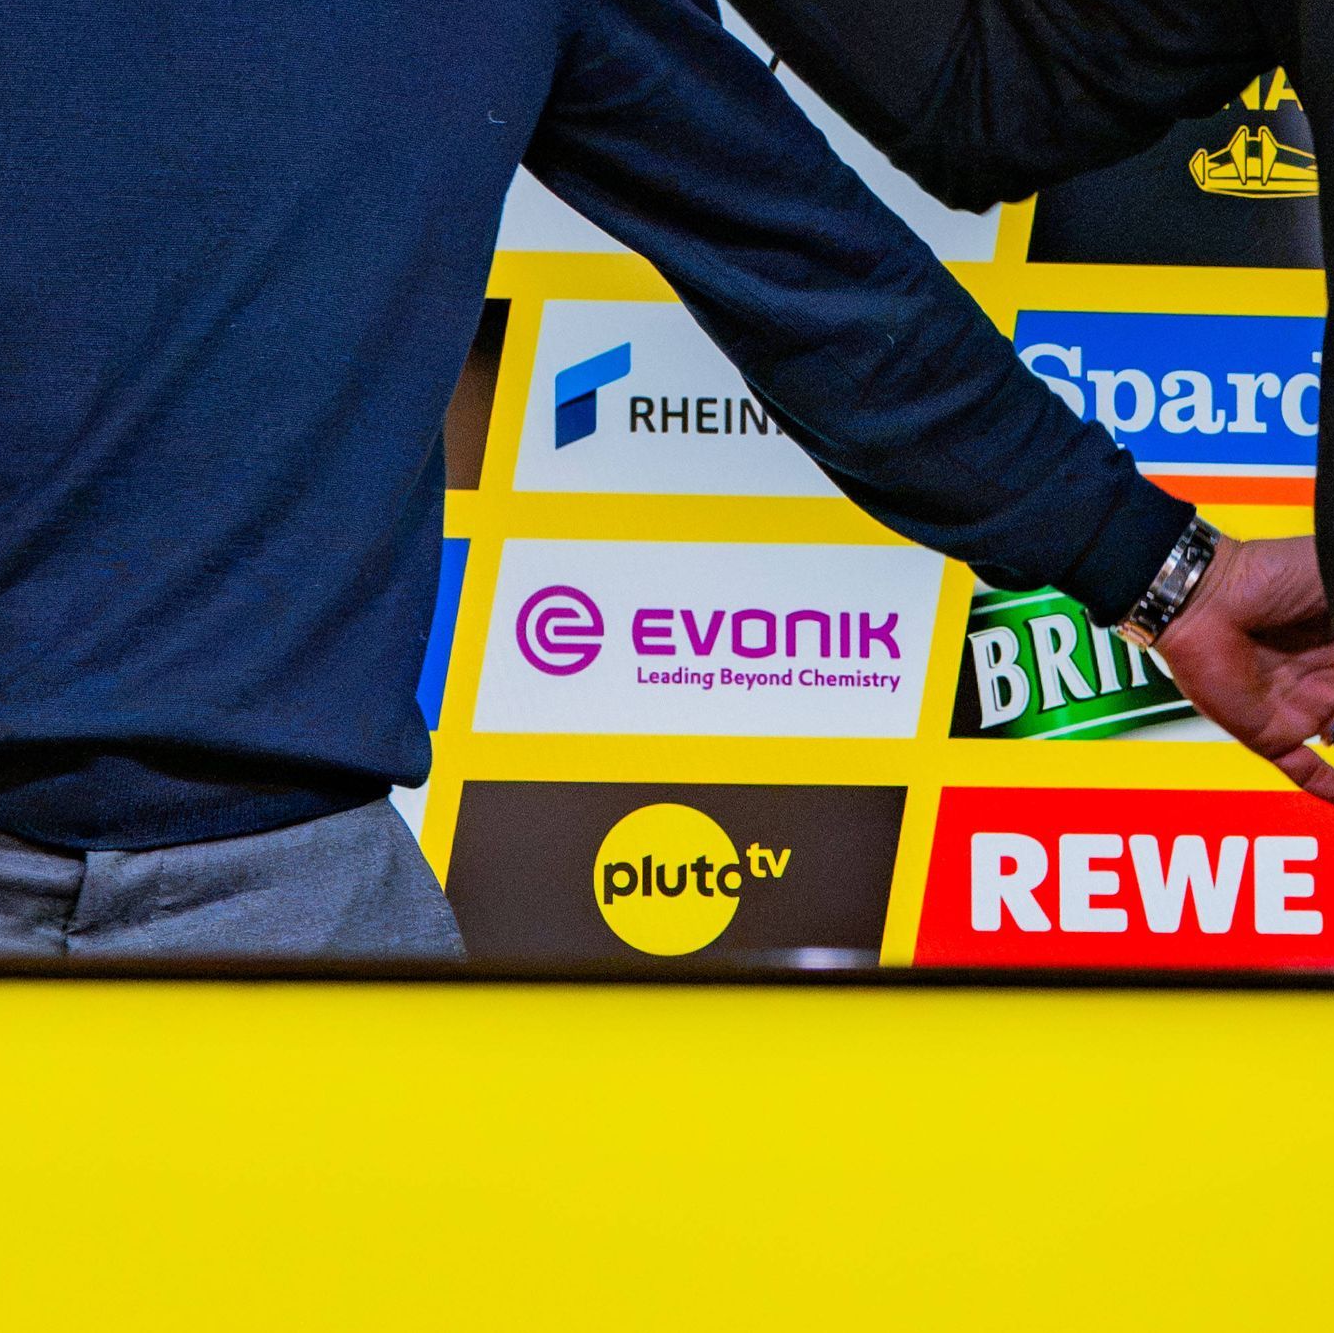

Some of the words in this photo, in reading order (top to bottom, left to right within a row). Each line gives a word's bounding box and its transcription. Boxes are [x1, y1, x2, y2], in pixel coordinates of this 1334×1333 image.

[629, 396, 782, 435] RHEIN
[632, 608, 901, 659] EVONIK
[636, 666, 715, 690] Leading
[720, 668, 793, 691] Beyond
[798, 669, 901, 693] Chemistry
[603, 854, 743, 905] pluto
[746, 842, 792, 879] tv
[971, 832, 1324, 935] REWE
